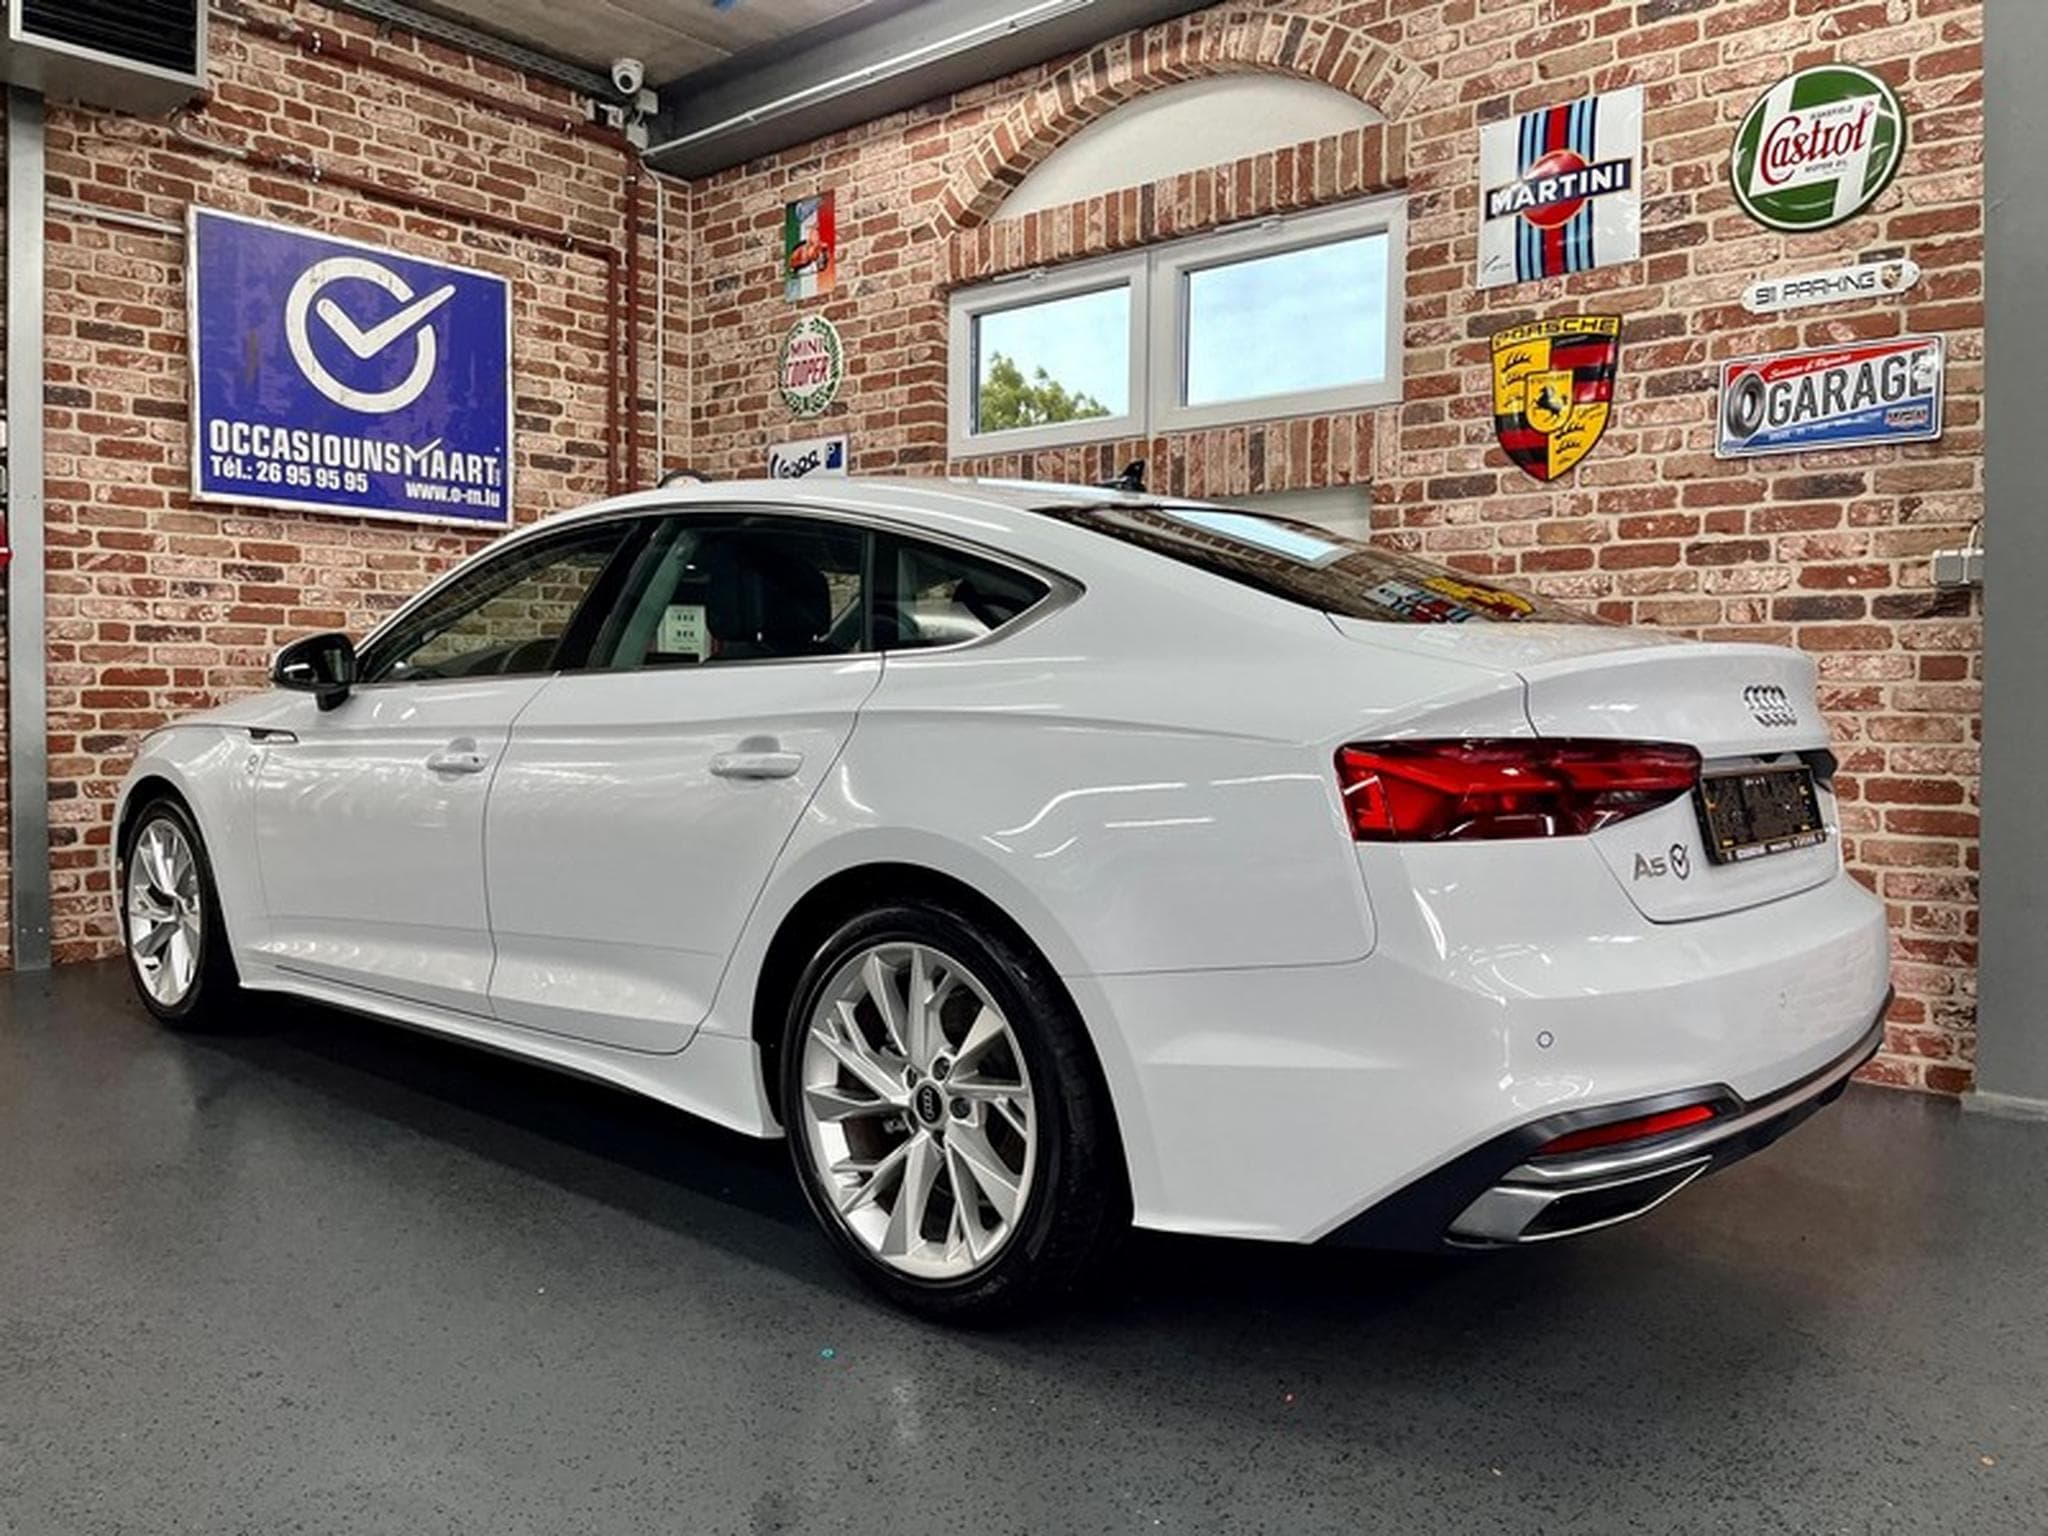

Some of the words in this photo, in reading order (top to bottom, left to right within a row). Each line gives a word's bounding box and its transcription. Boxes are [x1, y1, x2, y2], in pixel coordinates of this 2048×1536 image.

[1760, 101, 1875, 186] Castrol
[1490, 162, 1625, 217] MARTINI
[1783, 270, 1875, 300] PARKING
[790, 336, 824, 357] MINI
[1494, 317, 1617, 347] PORSCHE
[1767, 349, 1934, 427] GARAGE
[256, 461, 281, 485] 26
[286, 464, 312, 488] 95
[315, 468, 341, 491] 95
[344, 471, 369, 494] 95
[1633, 851, 1668, 881] A5
